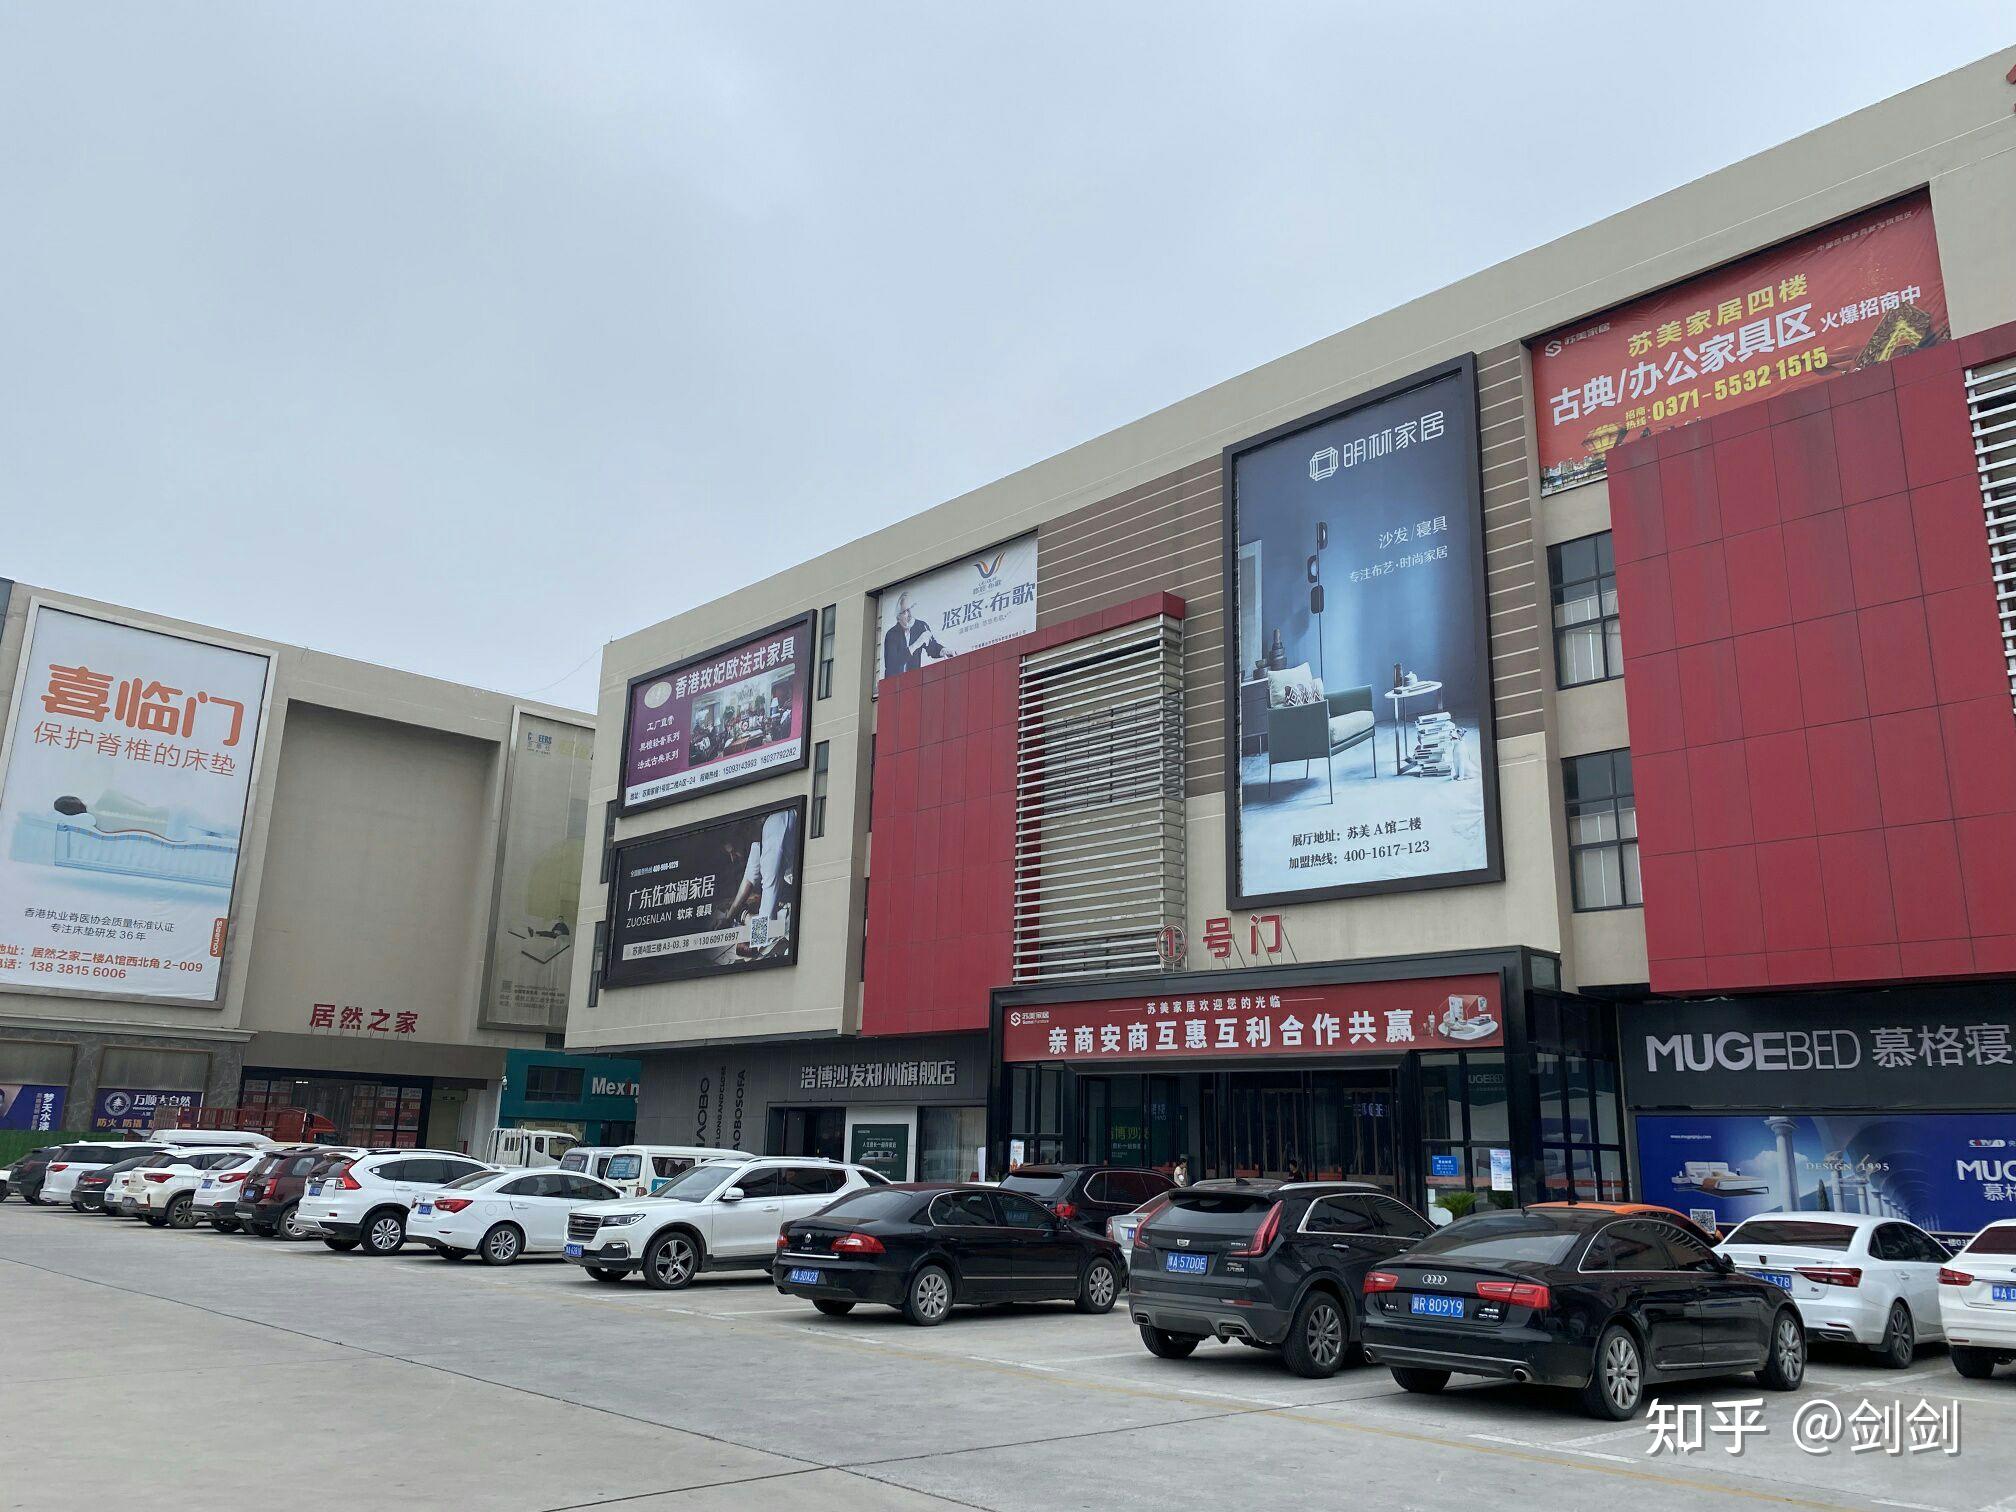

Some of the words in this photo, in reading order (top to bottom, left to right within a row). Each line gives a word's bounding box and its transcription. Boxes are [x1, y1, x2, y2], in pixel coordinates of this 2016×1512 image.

[1627, 274, 1808, 357] 苏美家居四楼
[1549, 303, 1816, 426] 古典/办公家具区
[1821, 285, 1921, 333] 火爆招商中
[1778, 346, 1829, 382] 1515
[1344, 411, 1444, 468] 明林家居
[675, 635, 795, 699] 香港玫妃欧法式家具
[40, 663, 245, 747] 喜临门
[33, 721, 236, 777] 保护脊椎的床垫
[1344, 841, 1430, 863] 400-1617-123
[51, 923, 117, 939] 专注床垫研发
[119, 930, 134, 940] 36
[135, 932, 146, 942] 年
[625, 911, 672, 928] ZUOSENLAN
[29, 961, 53, 973] 138
[57, 963, 89, 976] 3815
[93, 966, 127, 979] 6006
[163, 959, 203, 973] 2-009
[309, 1003, 418, 1034] 居然之家
[1147, 995, 1281, 1014] 苏美家居欢迎您的光临
[1048, 1009, 1415, 1055] 亲商安商互惠互利合作共赢
[1645, 1029, 1861, 1072] MUGEBED
[800, 1059, 957, 1089] 浩博沙发郑州旗舰店
[133, 1094, 192, 1108] 万顺大自然
[696, 1077, 710, 1147] AOBO
[1806, 1162, 1852, 1171] DESIGN
[1861, 1162, 1890, 1172] 1995
